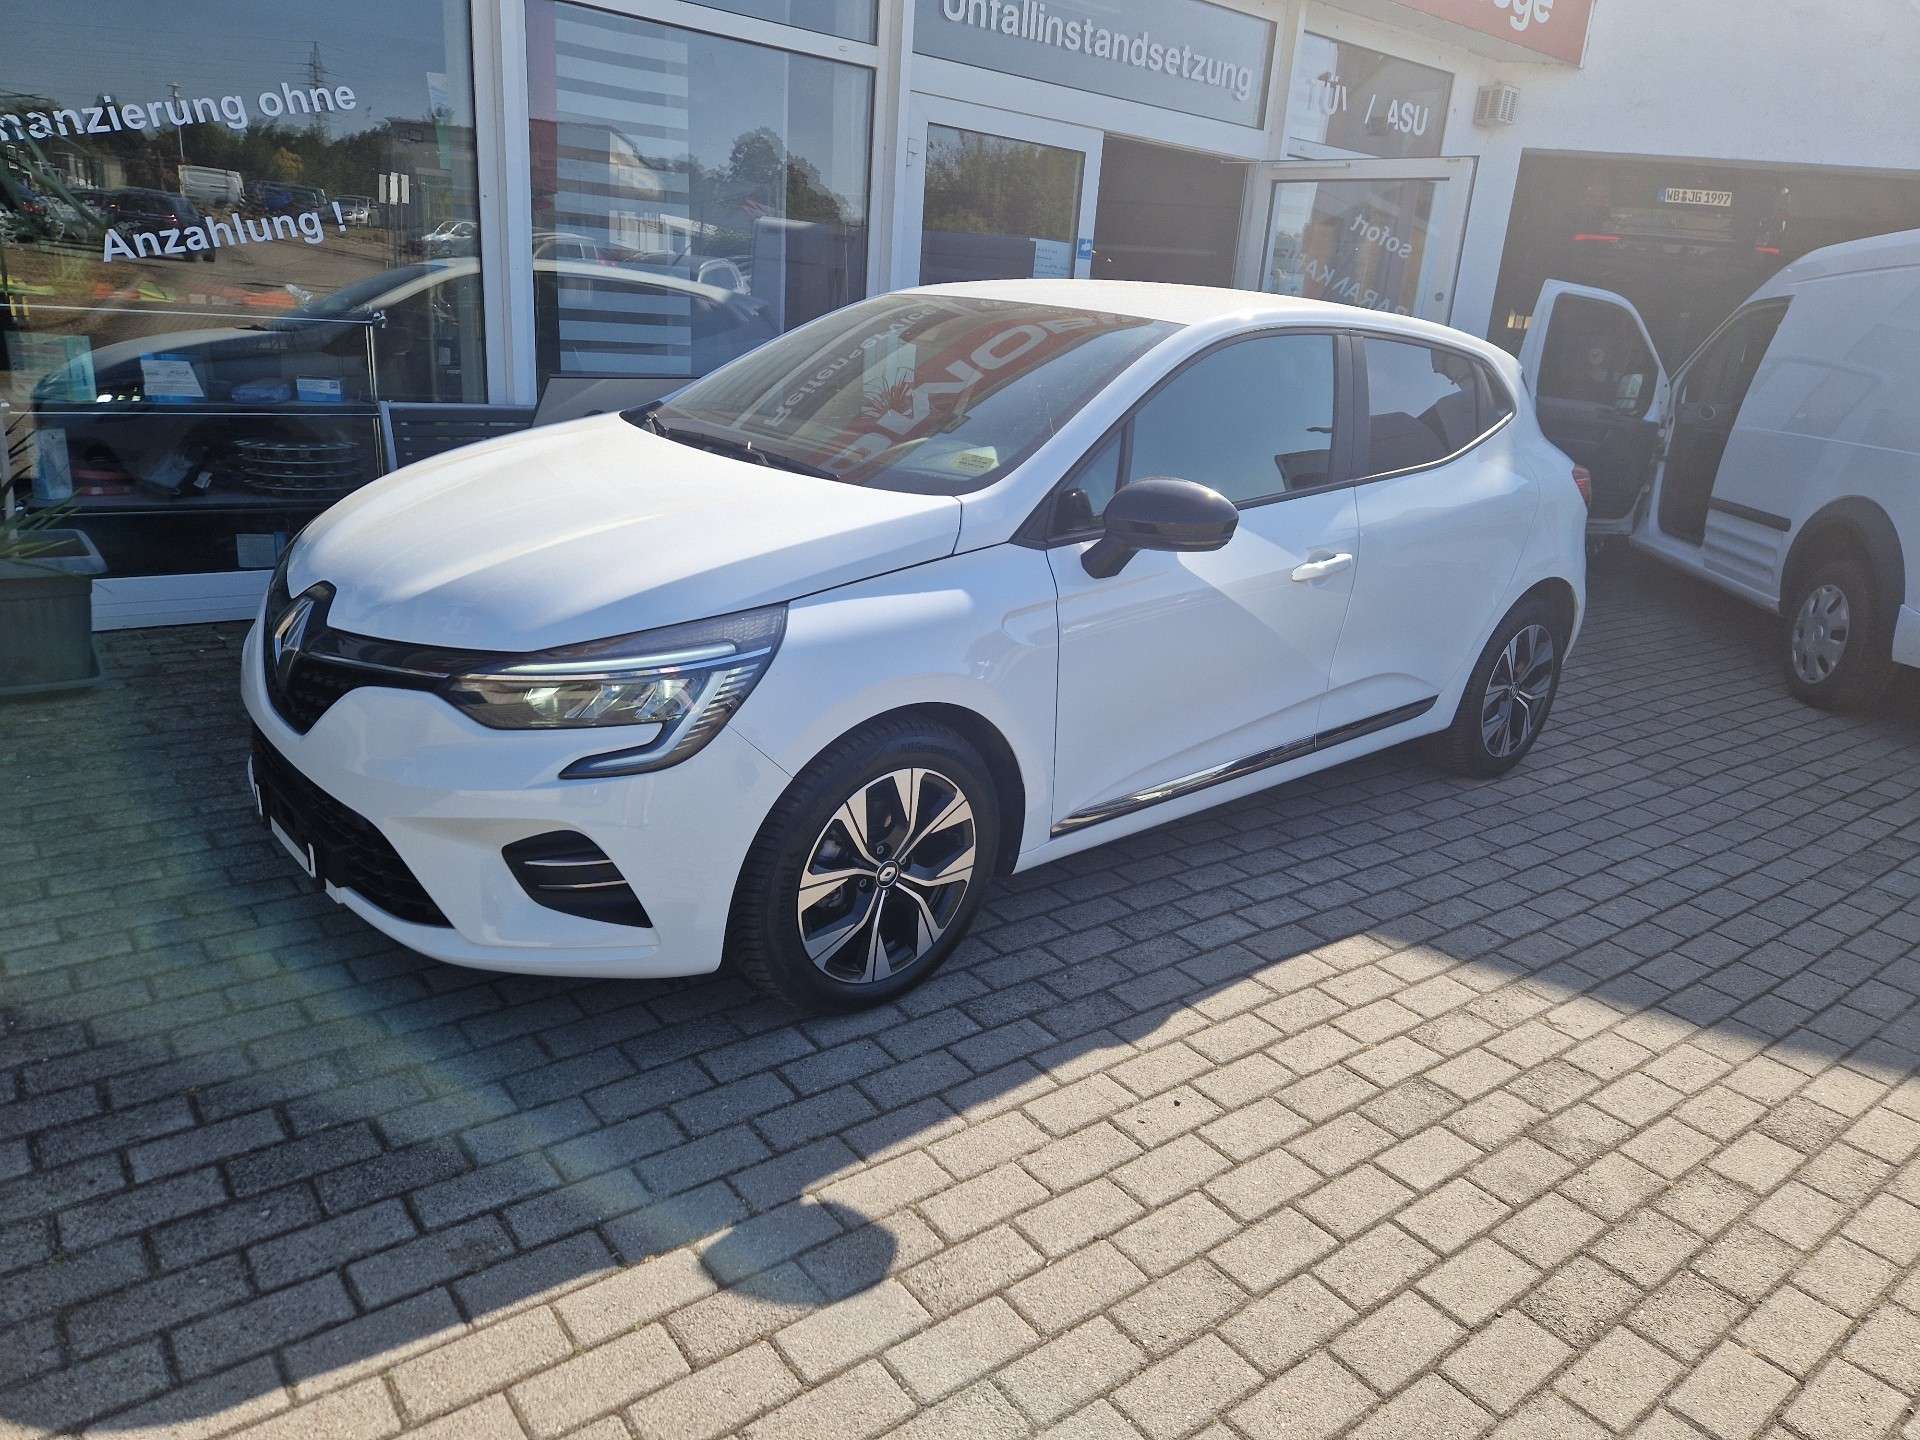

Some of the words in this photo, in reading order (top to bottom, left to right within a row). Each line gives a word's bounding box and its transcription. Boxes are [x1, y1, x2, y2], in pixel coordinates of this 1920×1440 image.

[1493, 0, 1554, 32] ge
[942, 0, 1251, 101] Unfallinstandsetzung
[258, 82, 357, 117] ohne
[1386, 97, 1430, 137] ASU
[1666, 189, 1680, 202] WB
[1704, 191, 1731, 206] 1997
[103, 210, 326, 263] Anzahlung
[331, 201, 347, 233] !
